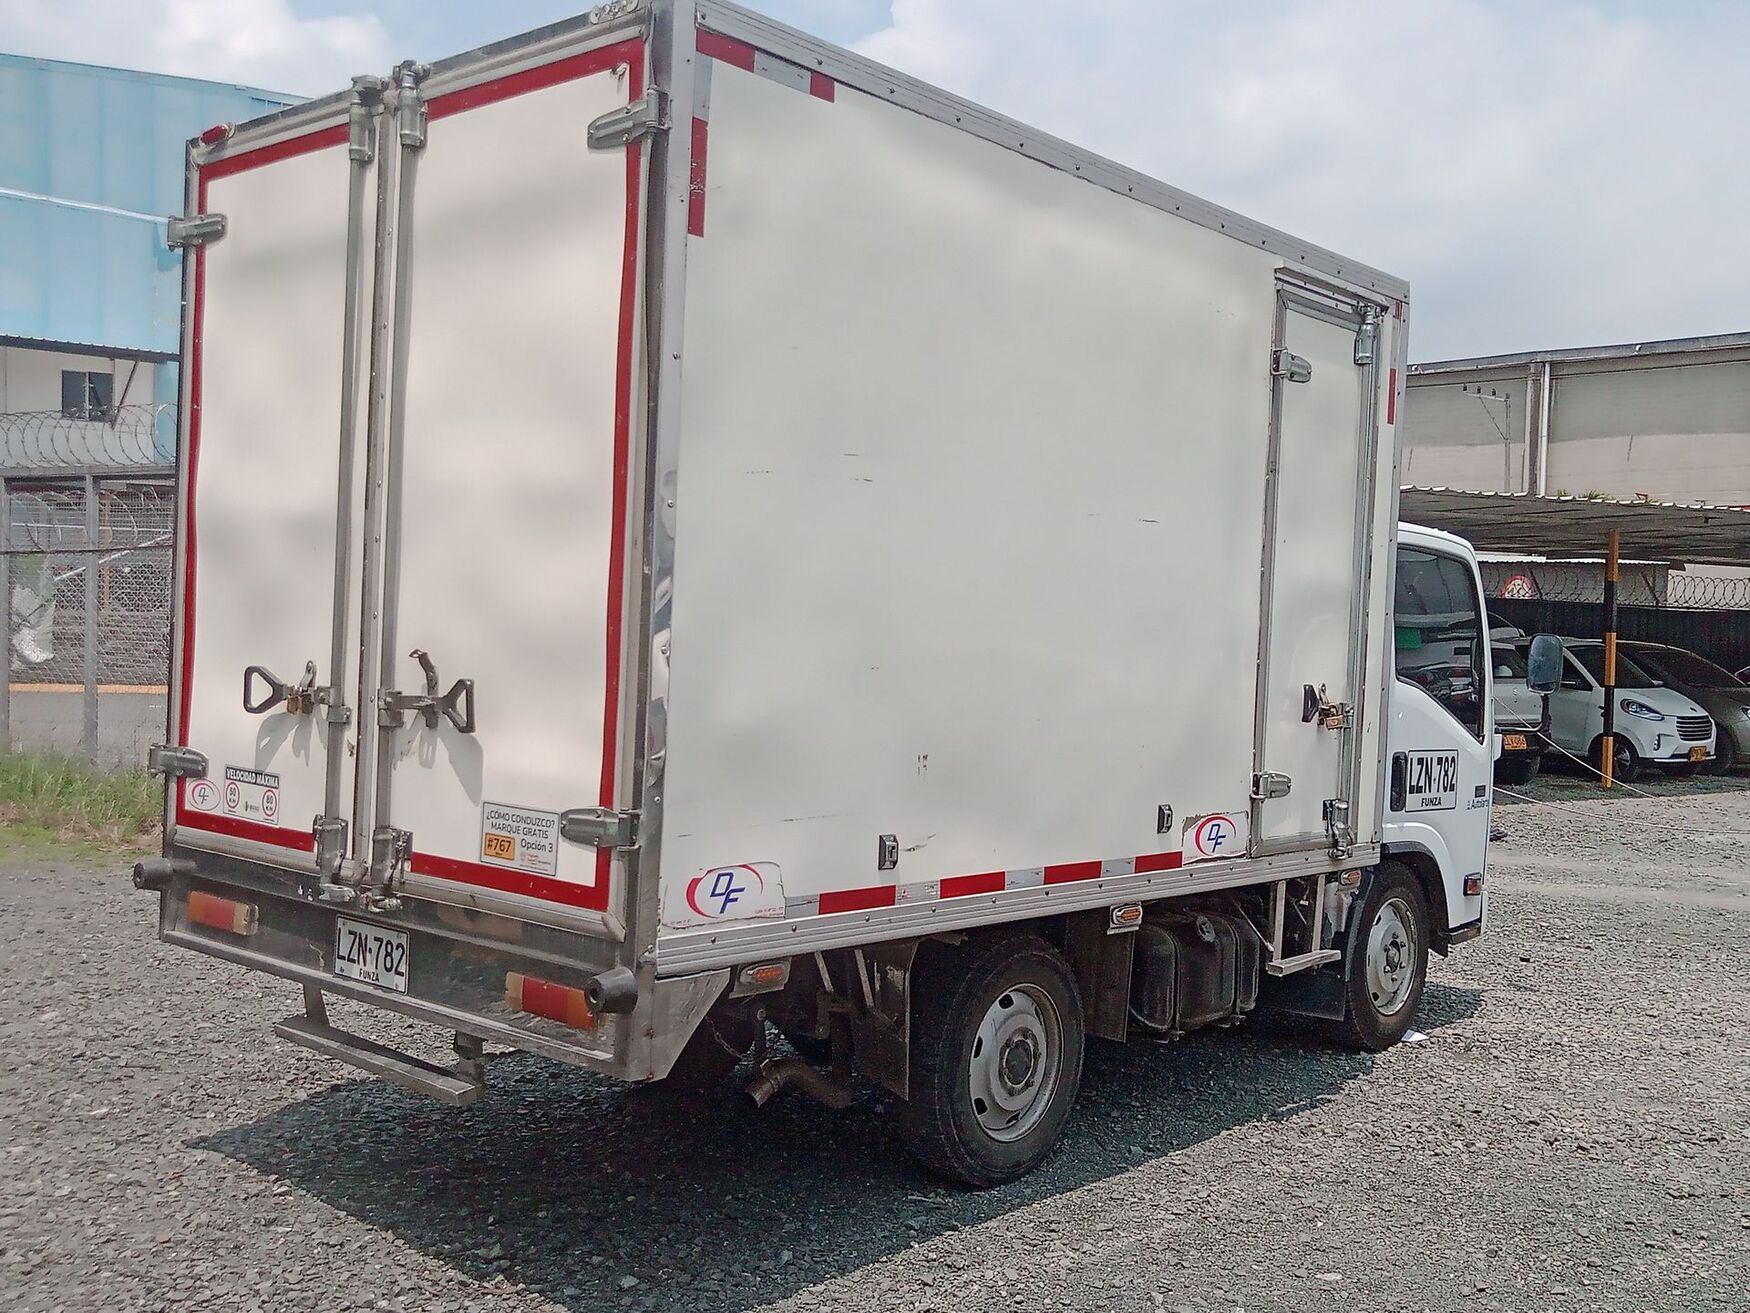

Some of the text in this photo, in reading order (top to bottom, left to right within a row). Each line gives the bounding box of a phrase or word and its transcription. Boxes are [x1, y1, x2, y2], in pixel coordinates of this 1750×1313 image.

[226, 768, 256, 783] VELOCIDAD
[1420, 797, 1442, 807] FUNZA
[511, 814, 555, 829] CONDUZCO?
[491, 822, 549, 839] MARQUE GRATIS
[487, 838, 512, 853] #767
[520, 838, 553, 853] Opción 3
[1207, 824, 1227, 853] DF
[709, 871, 746, 914] DF
[360, 968, 379, 982] FUNZA
